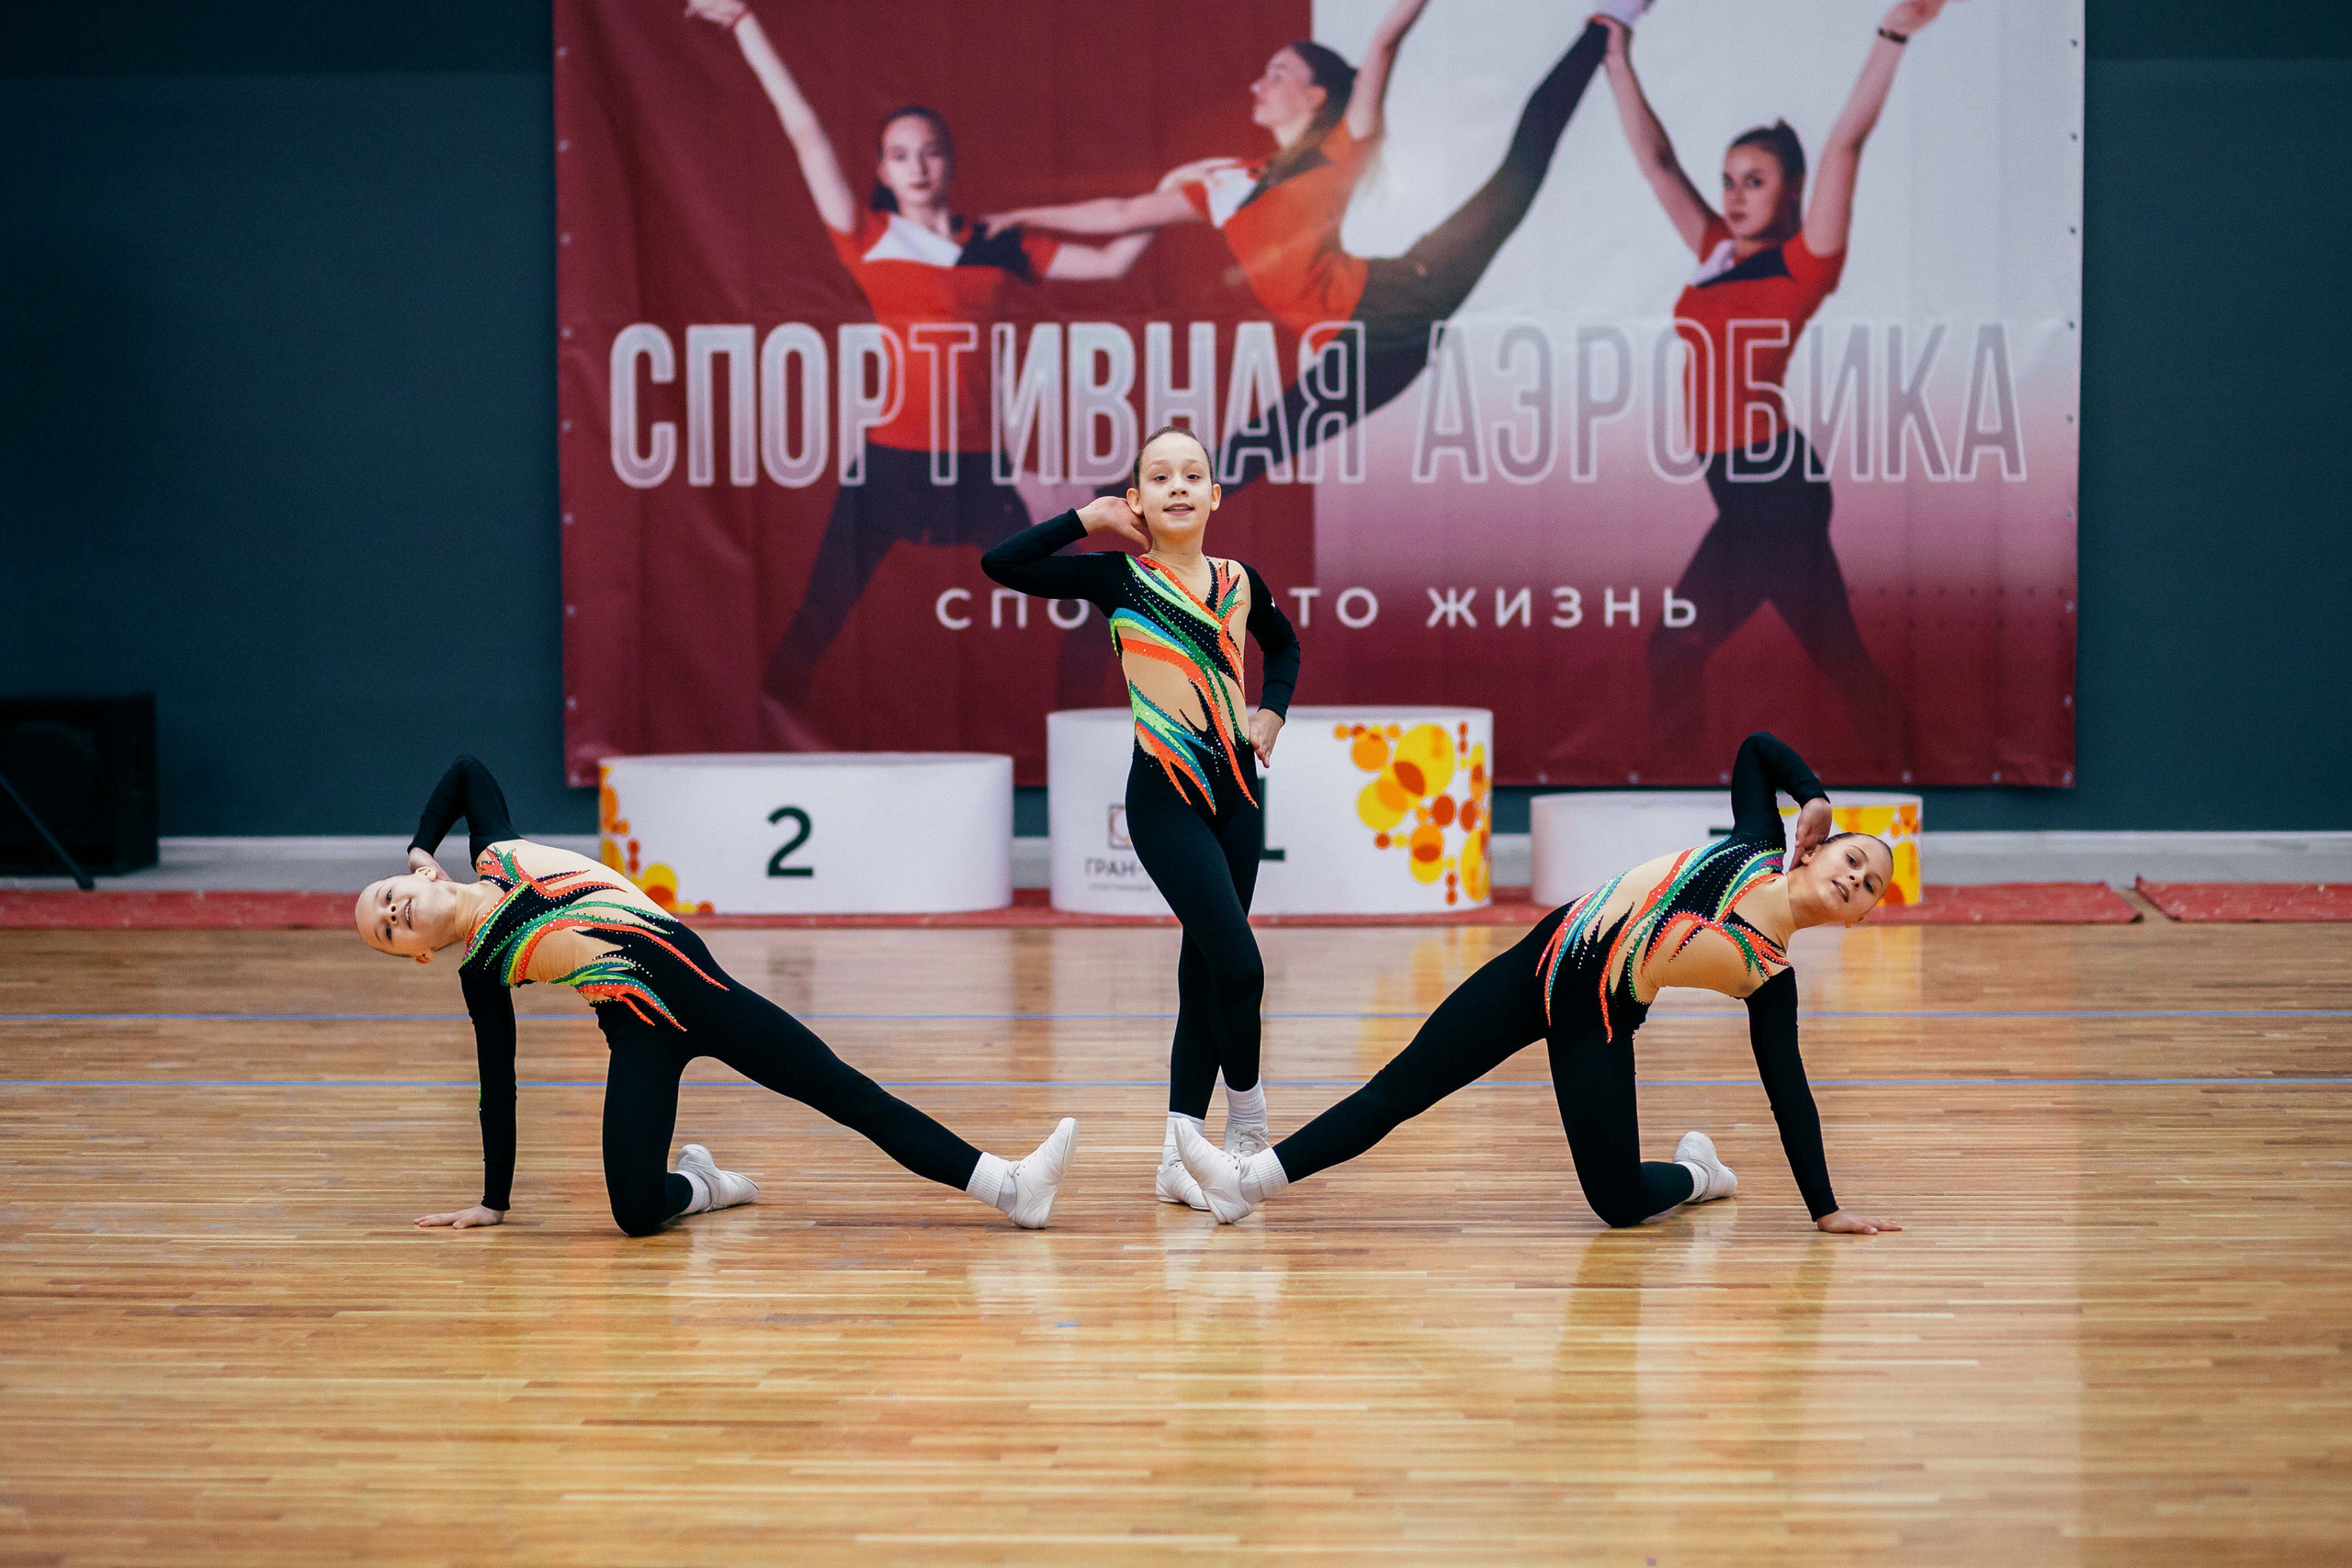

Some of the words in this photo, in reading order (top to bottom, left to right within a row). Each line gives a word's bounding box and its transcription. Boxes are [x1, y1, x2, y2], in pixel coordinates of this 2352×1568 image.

[610, 322, 1367, 488] СПОРТИВНАЯ
[1412, 320, 2027, 485] АЭРОБИКА
[936, 587, 1091, 630] СПО
[1289, 587, 1379, 629] ТО
[1427, 586, 1699, 628] ЖИЗНЬ
[766, 807, 814, 877] 2
